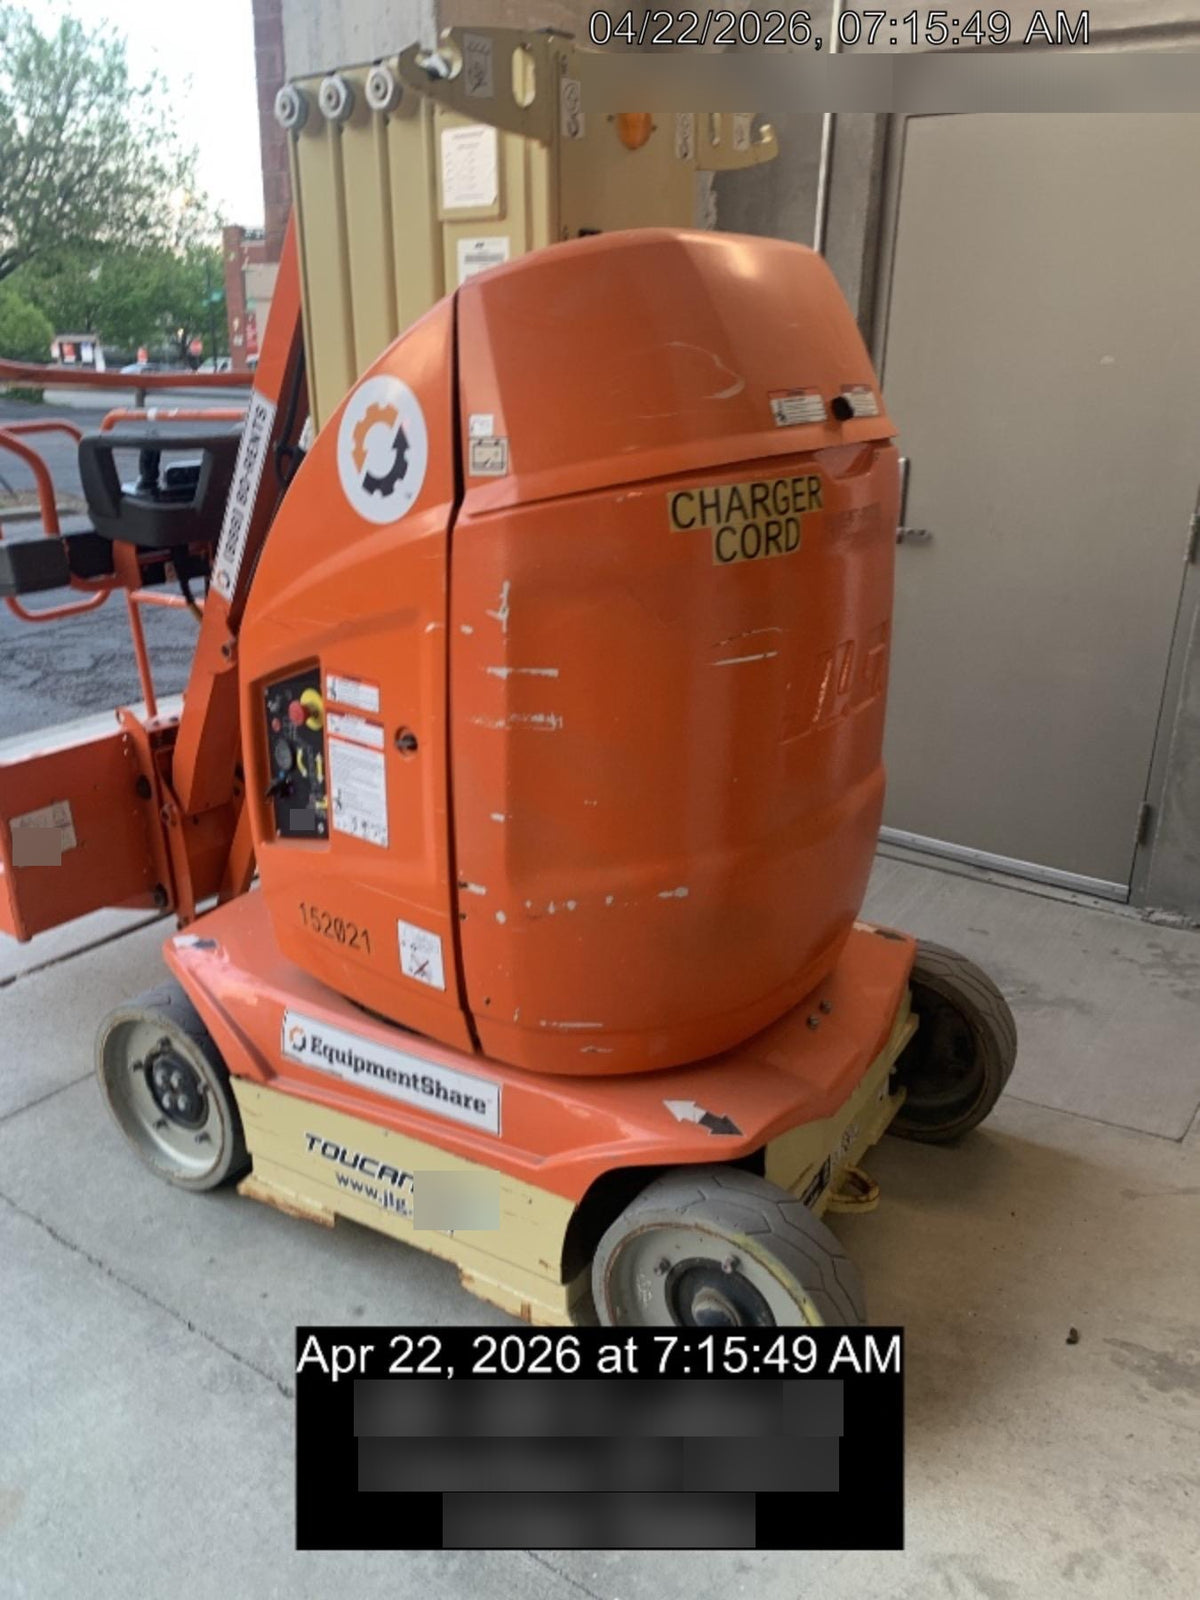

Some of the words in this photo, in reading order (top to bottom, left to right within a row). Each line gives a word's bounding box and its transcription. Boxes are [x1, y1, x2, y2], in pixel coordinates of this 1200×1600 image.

[671, 474, 823, 530] CHARGER
[715, 516, 801, 563] CORD
[298, 902, 371, 954] 152021
[310, 1035, 487, 1116] EquipmentShare
